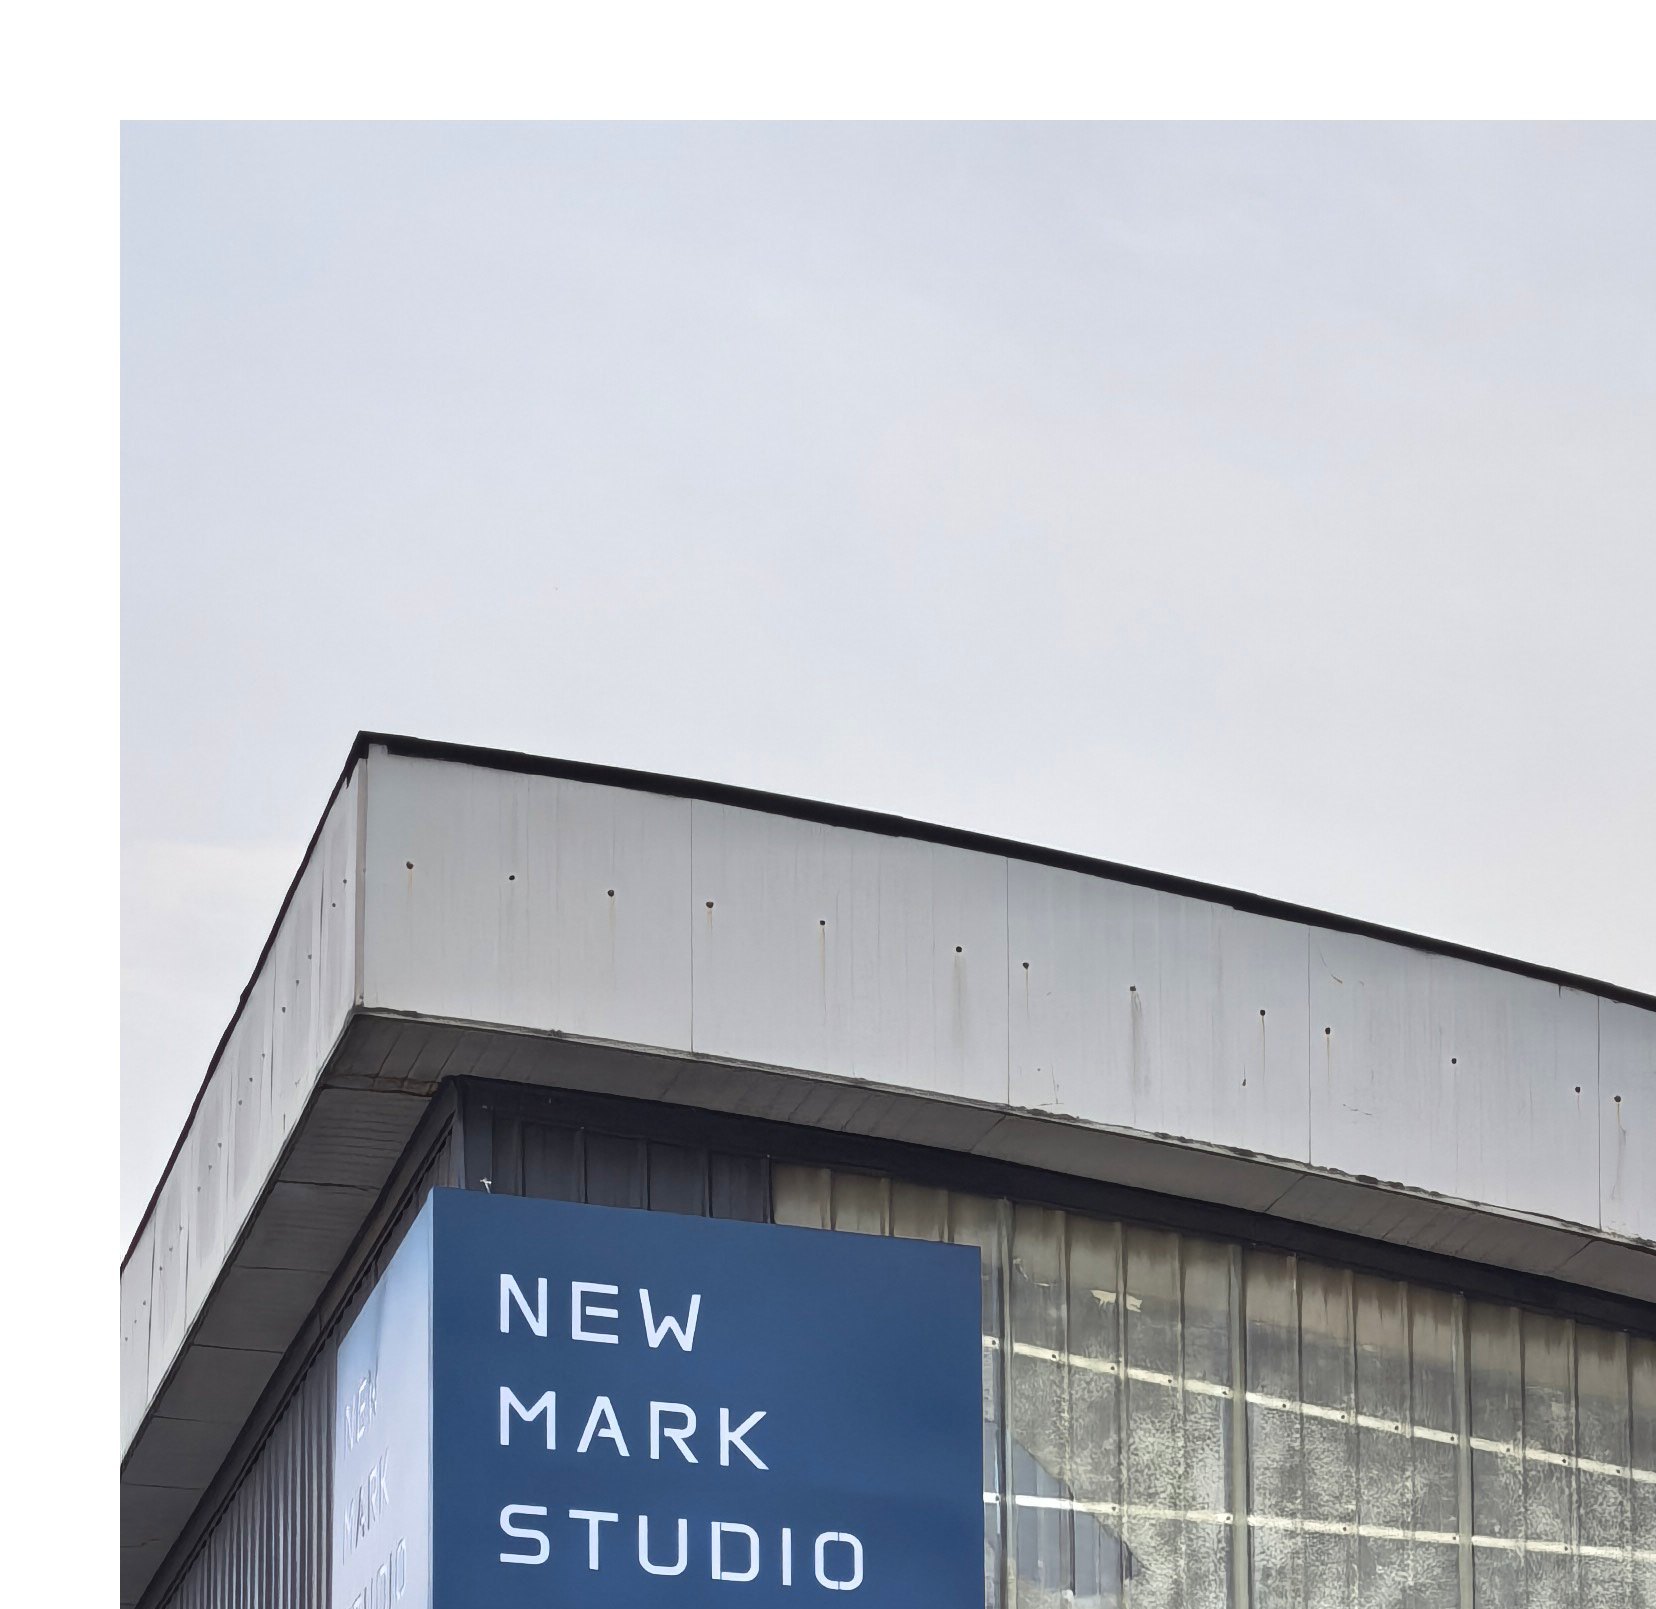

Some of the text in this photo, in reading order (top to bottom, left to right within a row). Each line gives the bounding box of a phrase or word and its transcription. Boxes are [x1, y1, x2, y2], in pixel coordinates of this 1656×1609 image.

[499, 1273, 702, 1352] NEW
[499, 1386, 770, 1471] MARK
[499, 1503, 865, 1591] STUDIO
